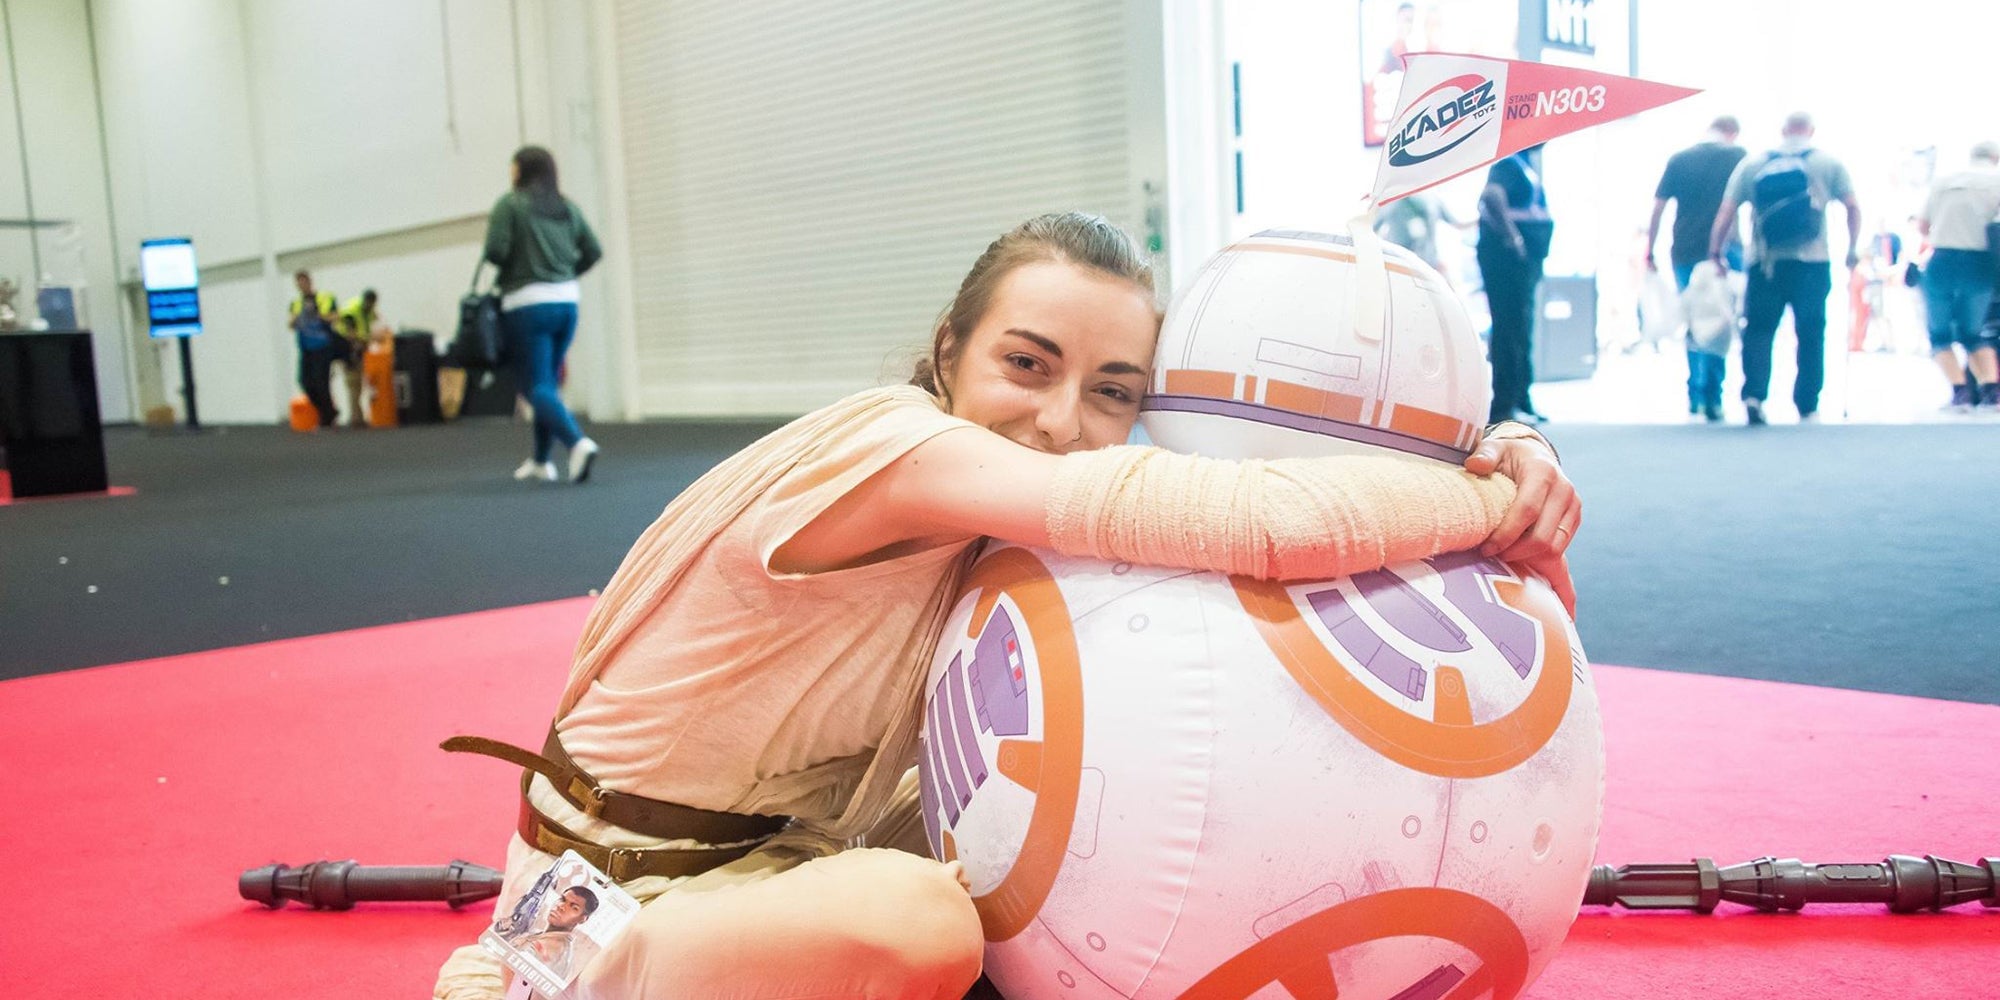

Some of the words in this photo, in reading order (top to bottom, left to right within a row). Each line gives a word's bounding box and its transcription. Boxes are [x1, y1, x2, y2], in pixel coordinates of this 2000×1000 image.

[1472, 103, 1496, 119] TOYZ
[1506, 104, 1534, 120] NO.
[1534, 85, 1607, 118] N303
[1509, 93, 1537, 104] STAND
[1389, 80, 1496, 157] BLADEZ
[507, 953, 558, 996] EXHIBITOR
